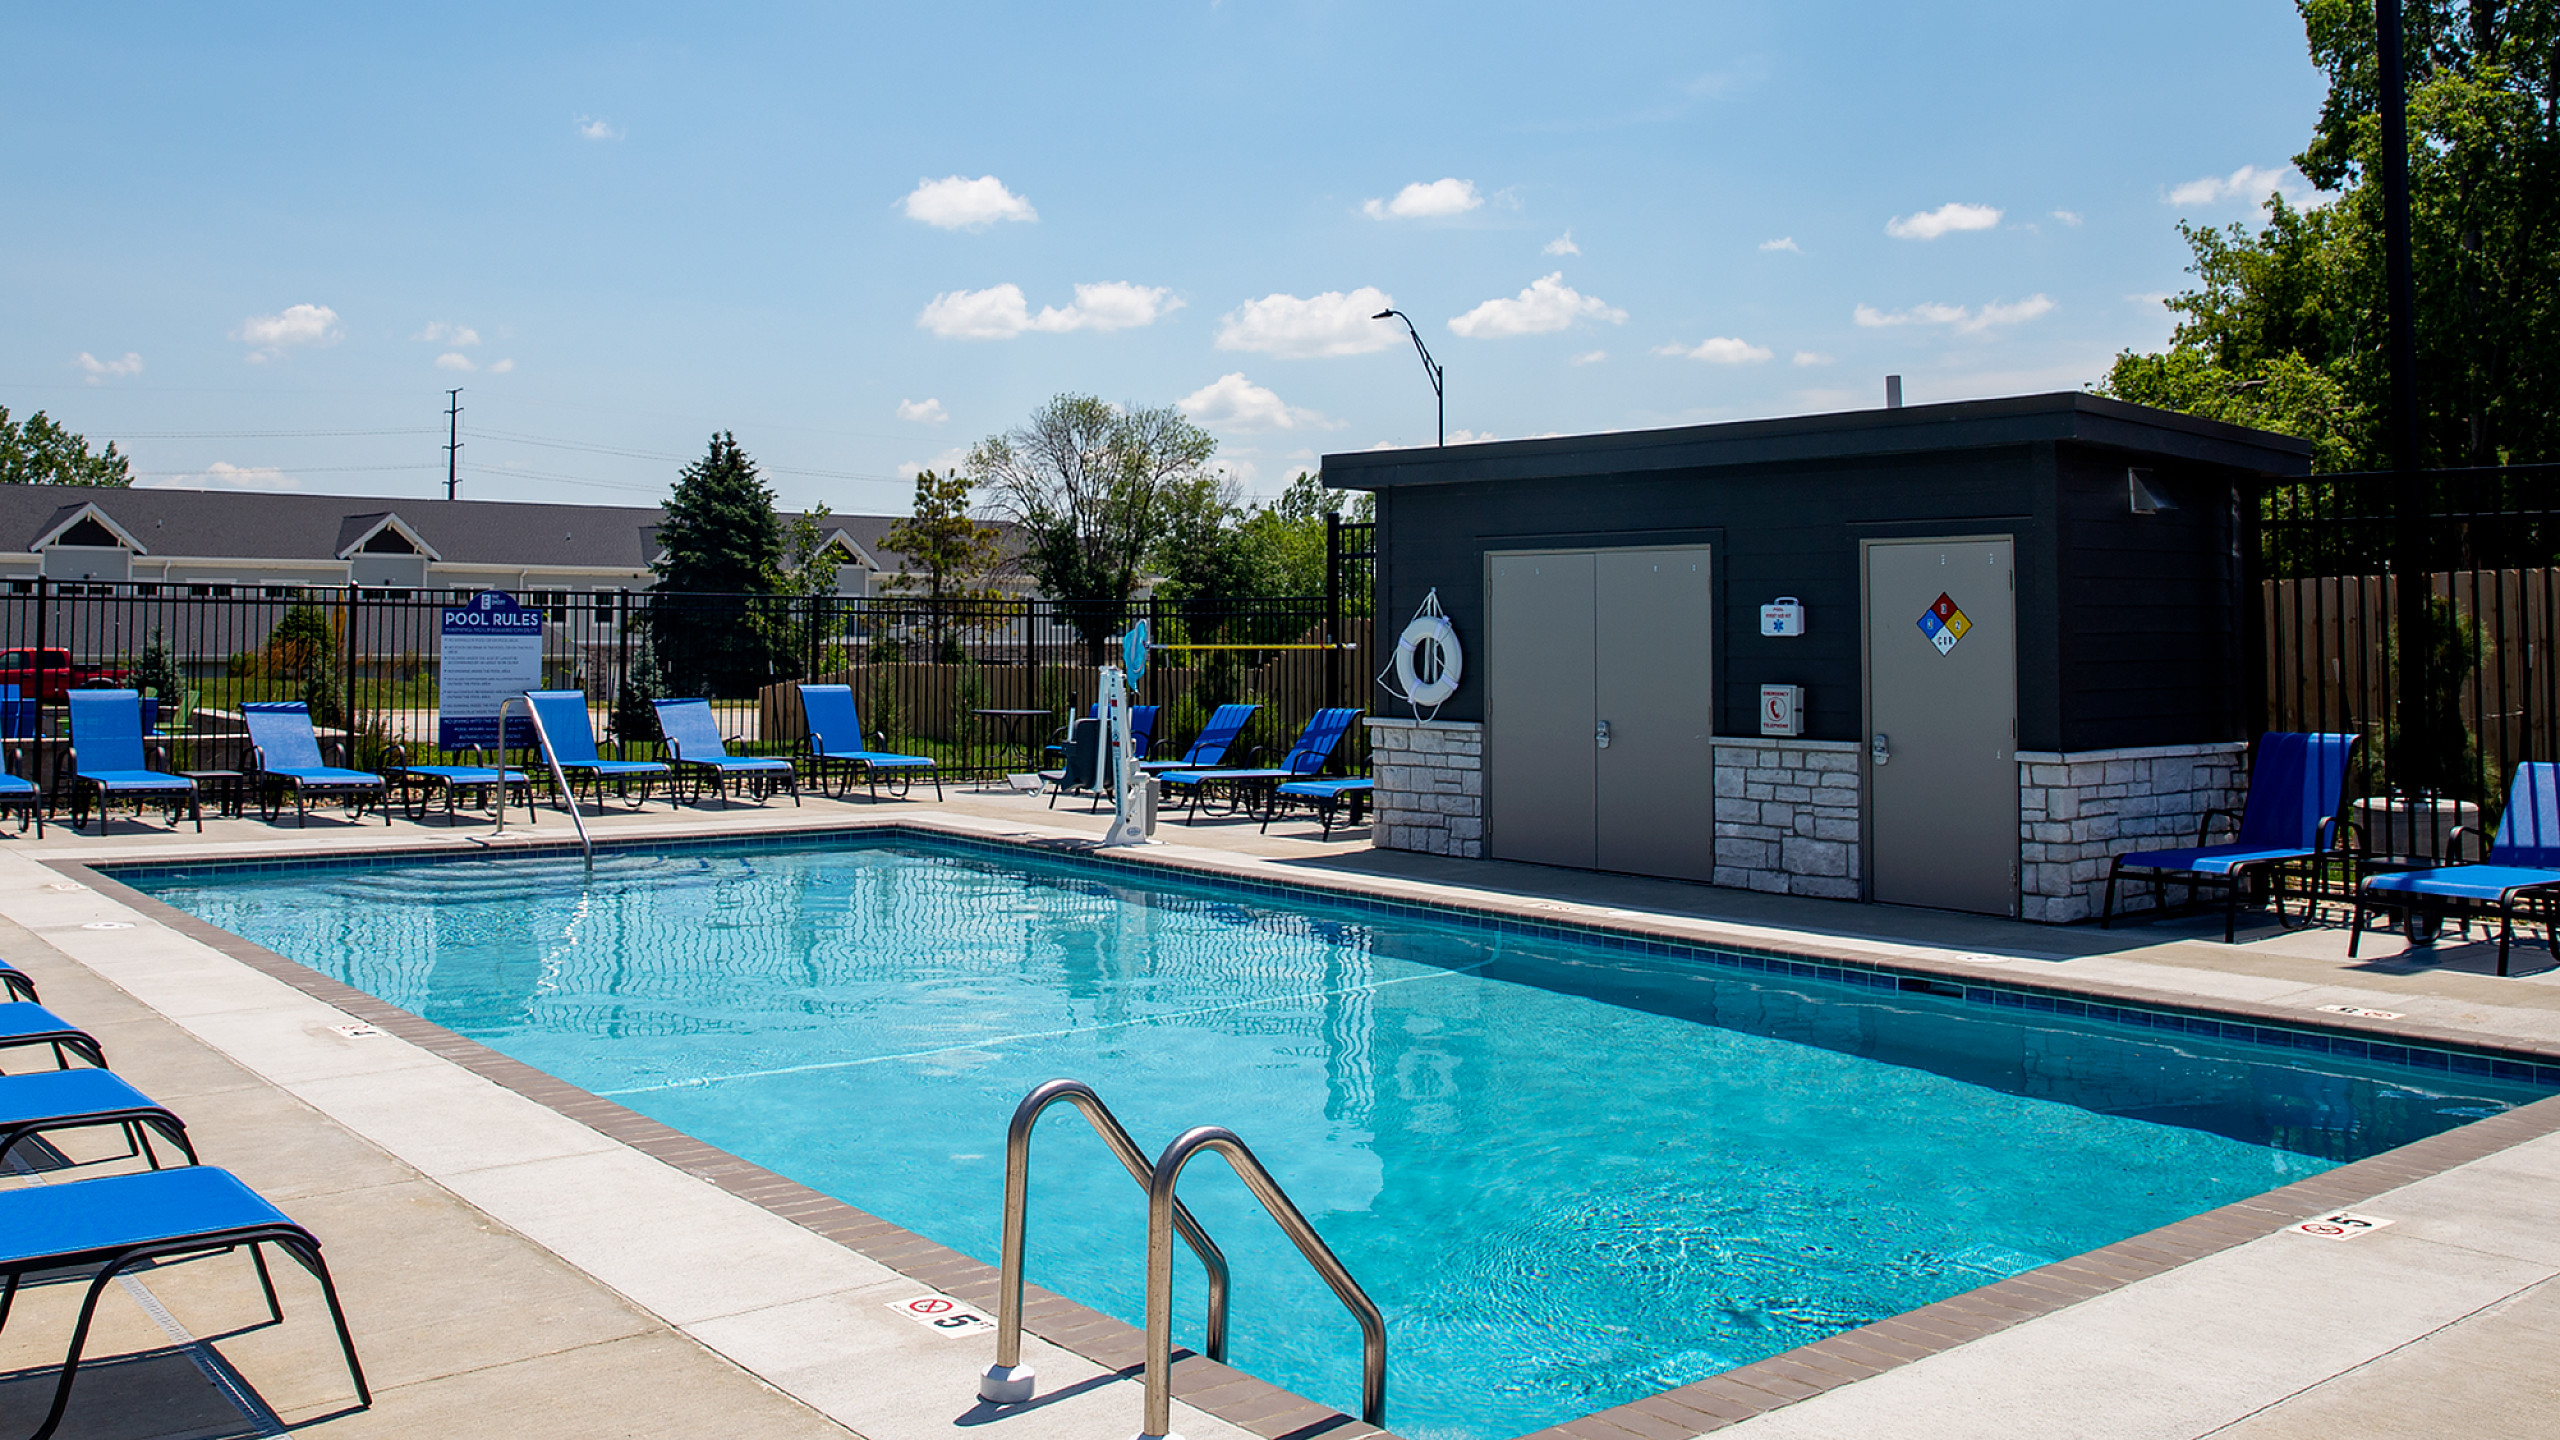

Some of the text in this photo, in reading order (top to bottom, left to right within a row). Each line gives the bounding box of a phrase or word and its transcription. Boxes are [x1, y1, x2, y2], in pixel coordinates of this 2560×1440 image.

[445, 612, 539, 626] POOL RULES
[2326, 1215, 2373, 1227] 5
[933, 1313, 981, 1328] 5
